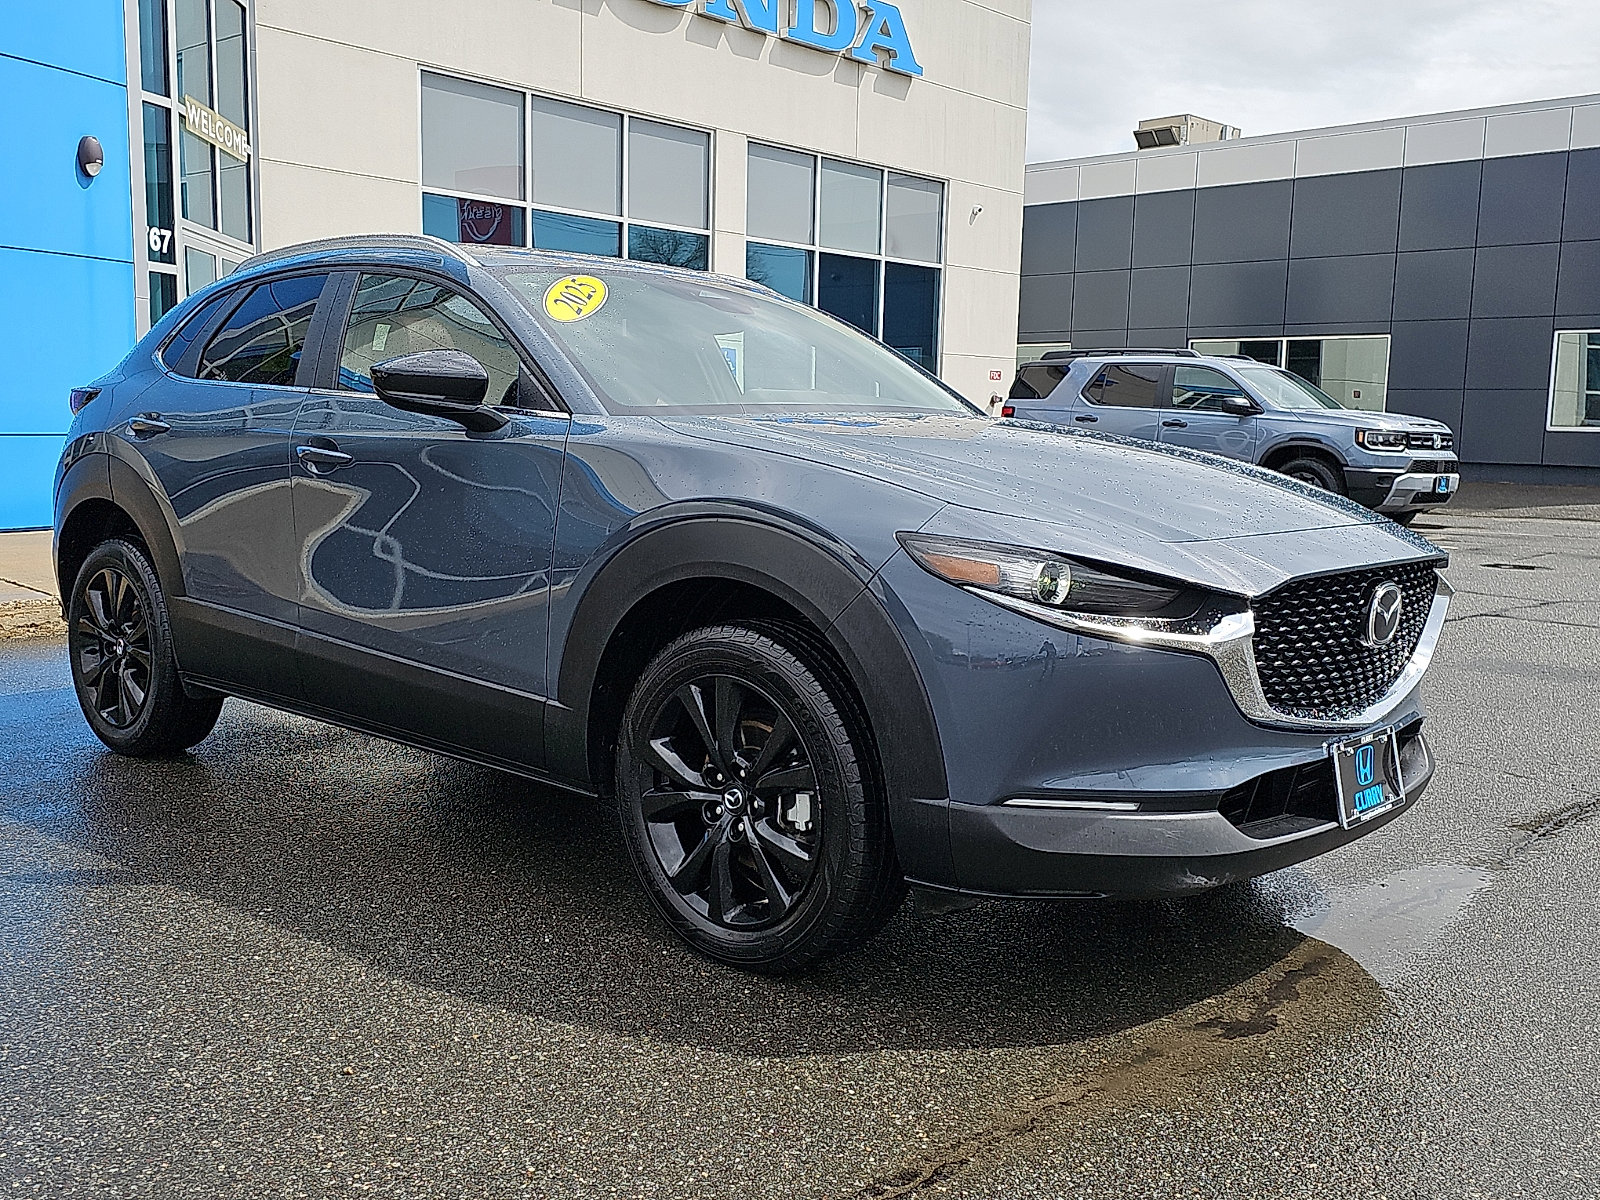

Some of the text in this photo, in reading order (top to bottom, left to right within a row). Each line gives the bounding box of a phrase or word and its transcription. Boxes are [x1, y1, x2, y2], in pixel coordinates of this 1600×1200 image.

[652, 0, 923, 76] DA
[187, 101, 248, 157] WELCOME
[147, 226, 172, 253] 67
[553, 278, 597, 315] 2025
[1355, 783, 1385, 812] CURRY
